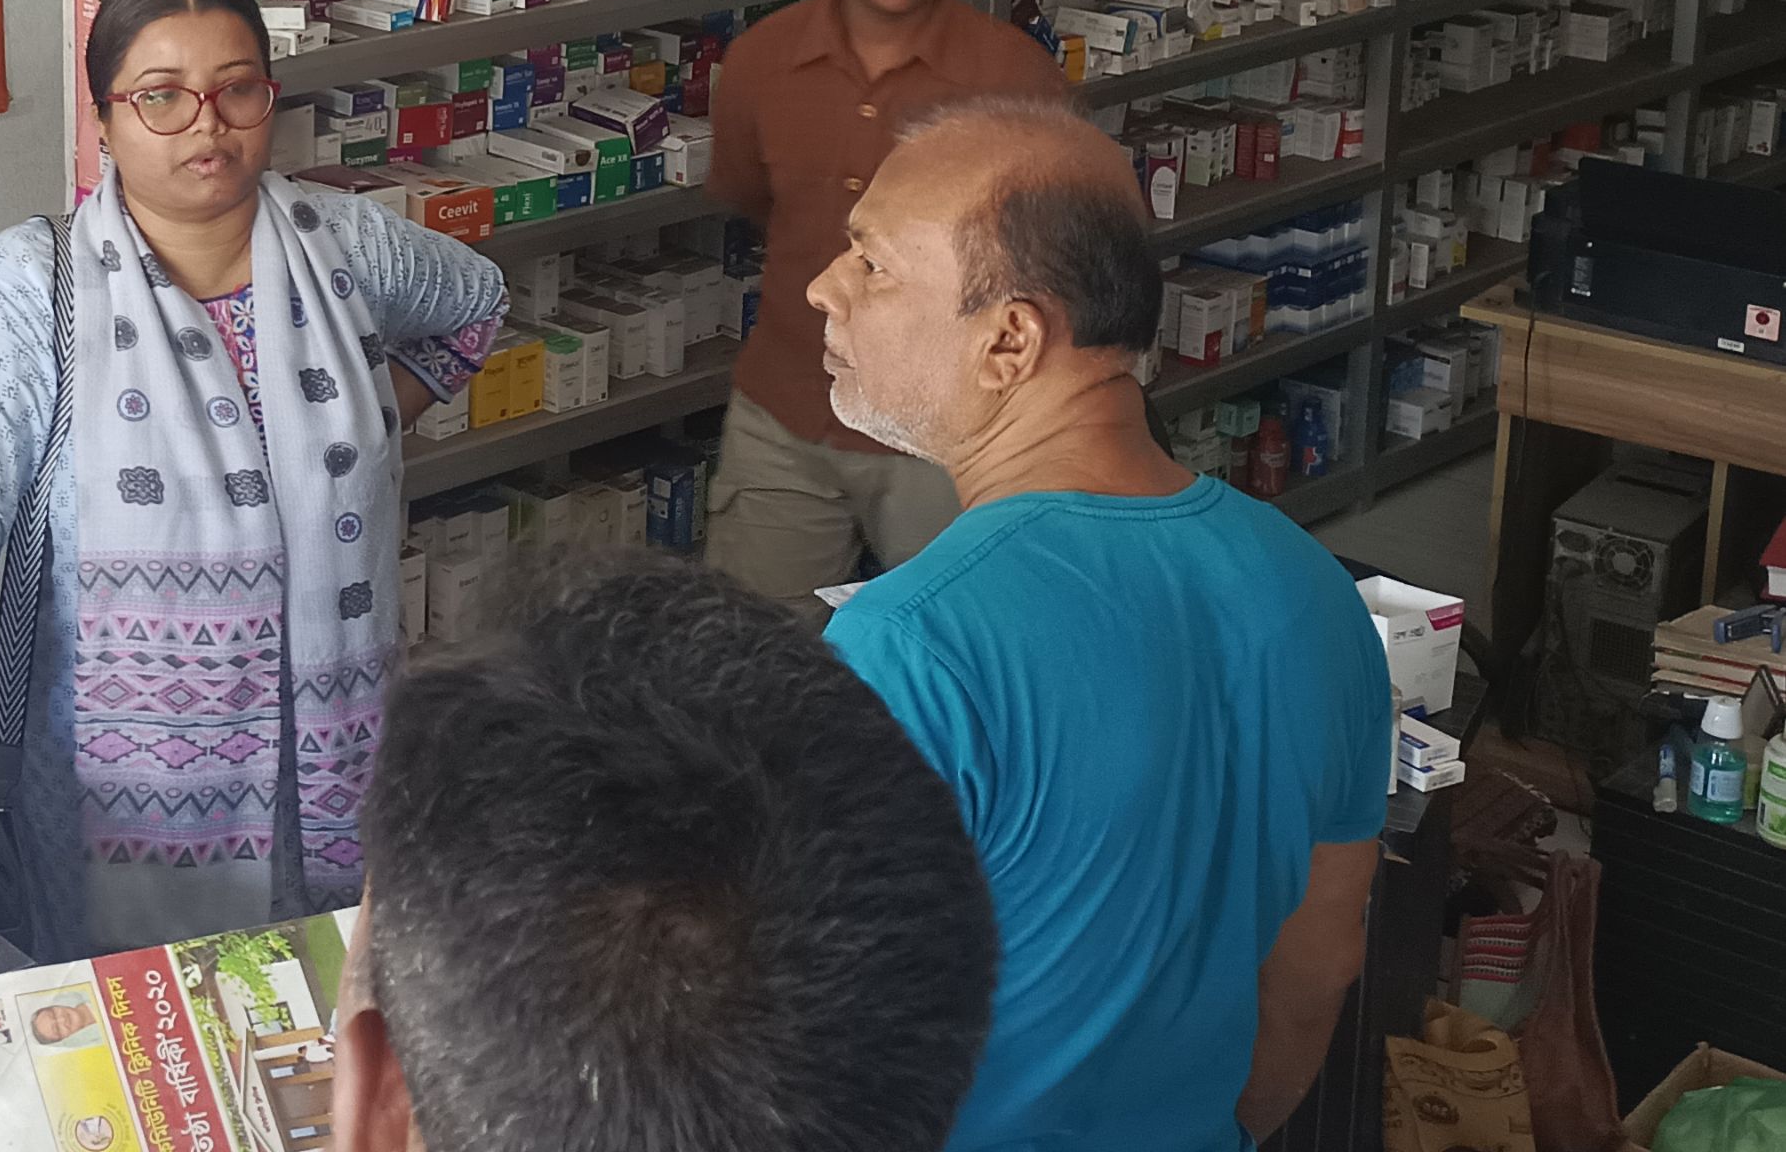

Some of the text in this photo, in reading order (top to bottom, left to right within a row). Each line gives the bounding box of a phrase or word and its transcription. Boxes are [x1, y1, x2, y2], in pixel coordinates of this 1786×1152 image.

[345, 153, 378, 167] Suzyme
[600, 154, 615, 166] Ace
[439, 200, 478, 221] Ceevit
[522, 192, 530, 215] Flexi
[106, 977, 152, 1075] ক্লিনিক দিবস
